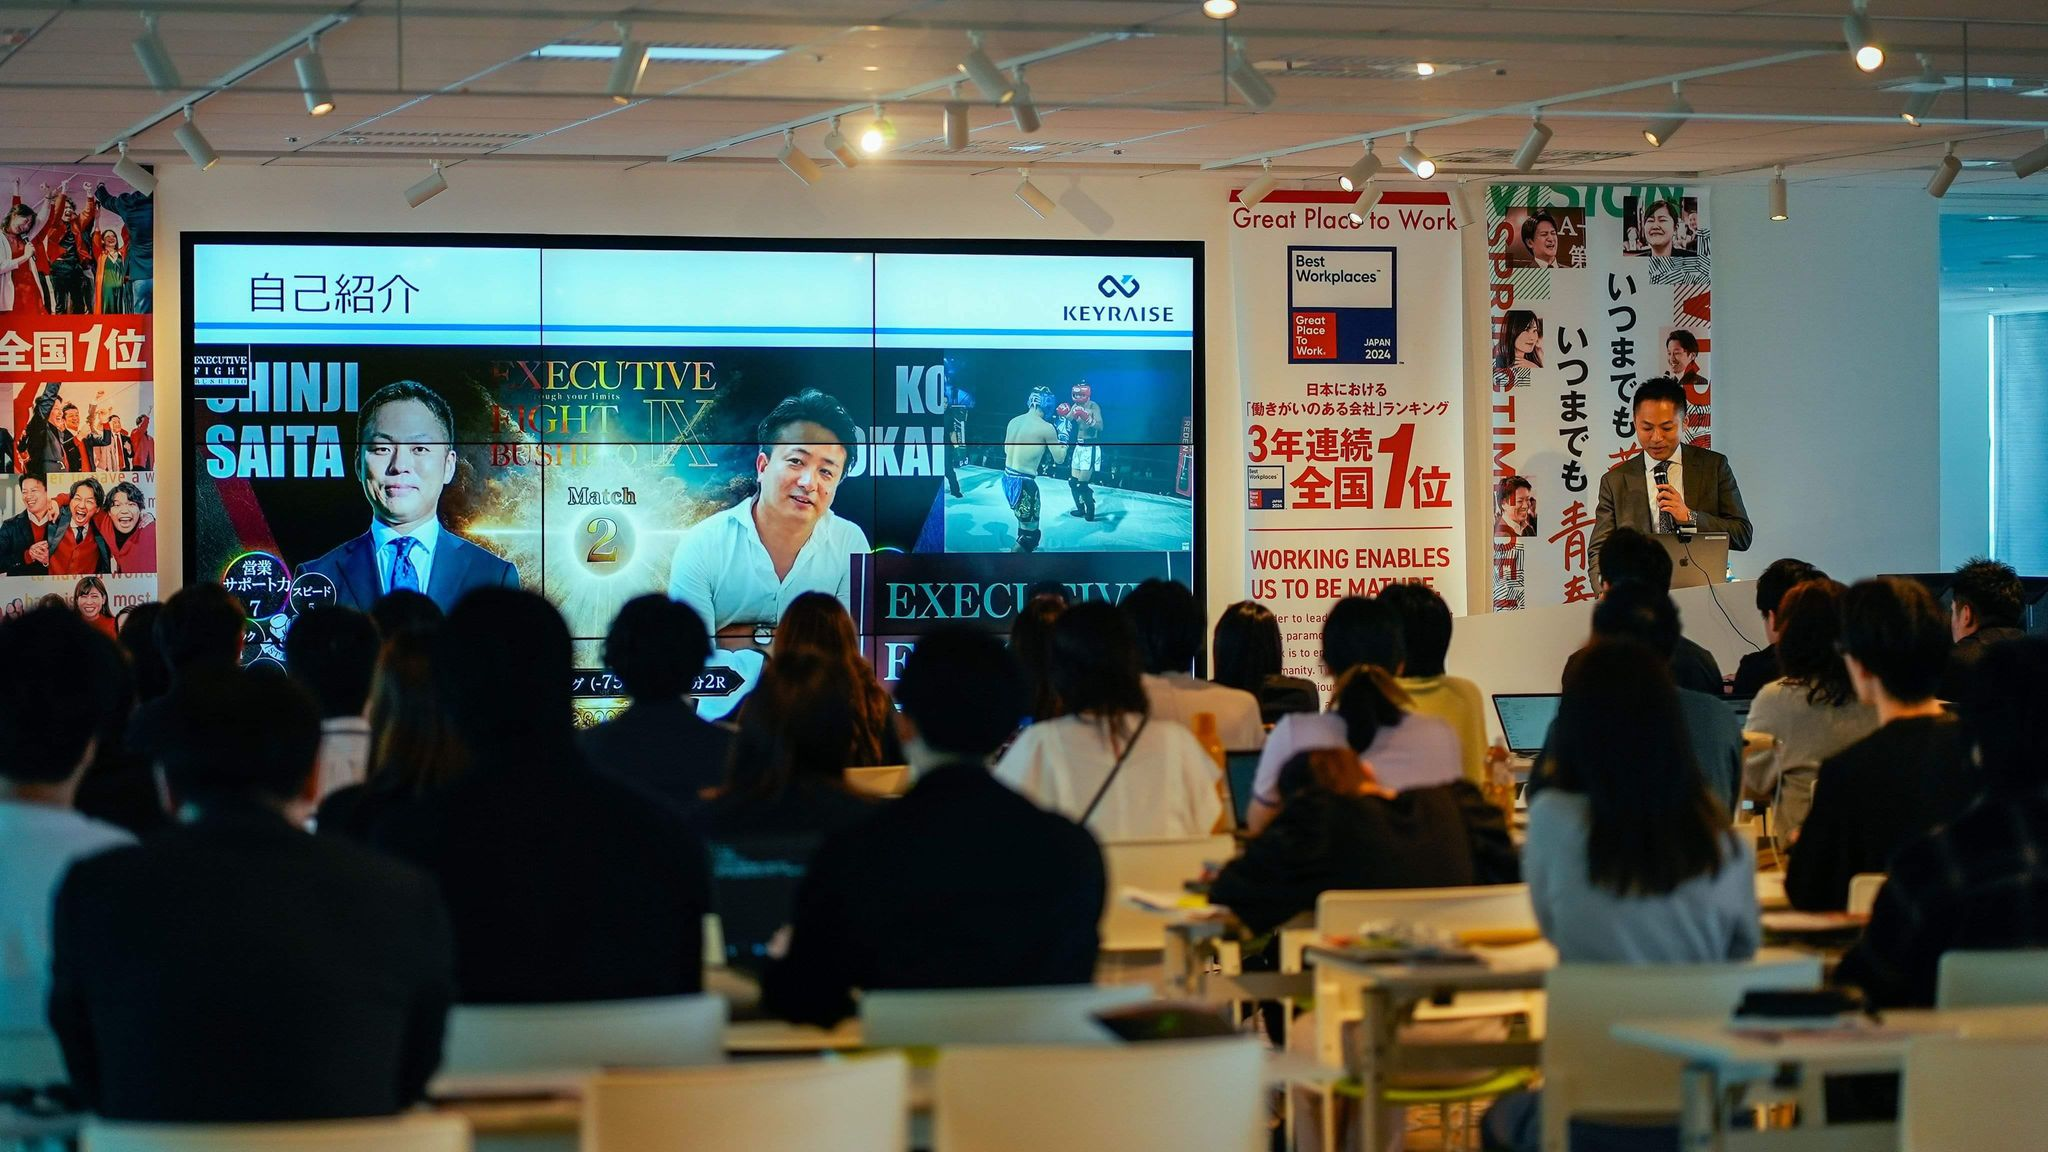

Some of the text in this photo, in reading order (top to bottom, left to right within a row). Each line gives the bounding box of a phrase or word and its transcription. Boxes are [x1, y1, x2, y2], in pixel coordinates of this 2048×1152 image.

[1233, 207, 1296, 229] Great
[1369, 211, 1390, 230] to
[1398, 208, 1458, 231] Work
[1296, 254, 1325, 267] Best
[1296, 269, 1377, 285] Workplaces
[250, 272, 420, 314] 自己紹介
[1063, 305, 1174, 323] KEYRAISE
[1296, 315, 1326, 325] Great
[1296, 325, 1326, 335] Place
[0, 323, 147, 373] 全国1位
[1296, 336, 1308, 345] To
[1364, 338, 1391, 347] JAPAN
[194, 356, 247, 365] EXECUTIVE
[1365, 349, 1391, 360] 2024
[194, 367, 247, 375] FIGHT
[491, 361, 718, 391] EXECUTIVE
[567, 394, 588, 402] your
[591, 392, 621, 401] limits
[1306, 382, 1387, 397] 日本における
[1246, 401, 1450, 417] 「働きがいのある会社」ランキング
[491, 404, 619, 434] FIGHT
[206, 424, 345, 479] SAITA
[1248, 424, 1373, 463] 3年連続
[568, 487, 636, 505] Match
[587, 517, 617, 563] 2
[1250, 547, 1451, 570] WORKING ENABLES
[242, 560, 272, 576] 営業
[223, 577, 291, 593] サポート力
[292, 586, 331, 598] スピード
[1251, 579, 1277, 599] US
[1282, 579, 1309, 598] TO
[1315, 578, 1342, 598] BE
[250, 600, 261, 617] 7
[1292, 614, 1302, 623] to
[1288, 648, 1297, 658] is
[1300, 649, 1310, 658] to
